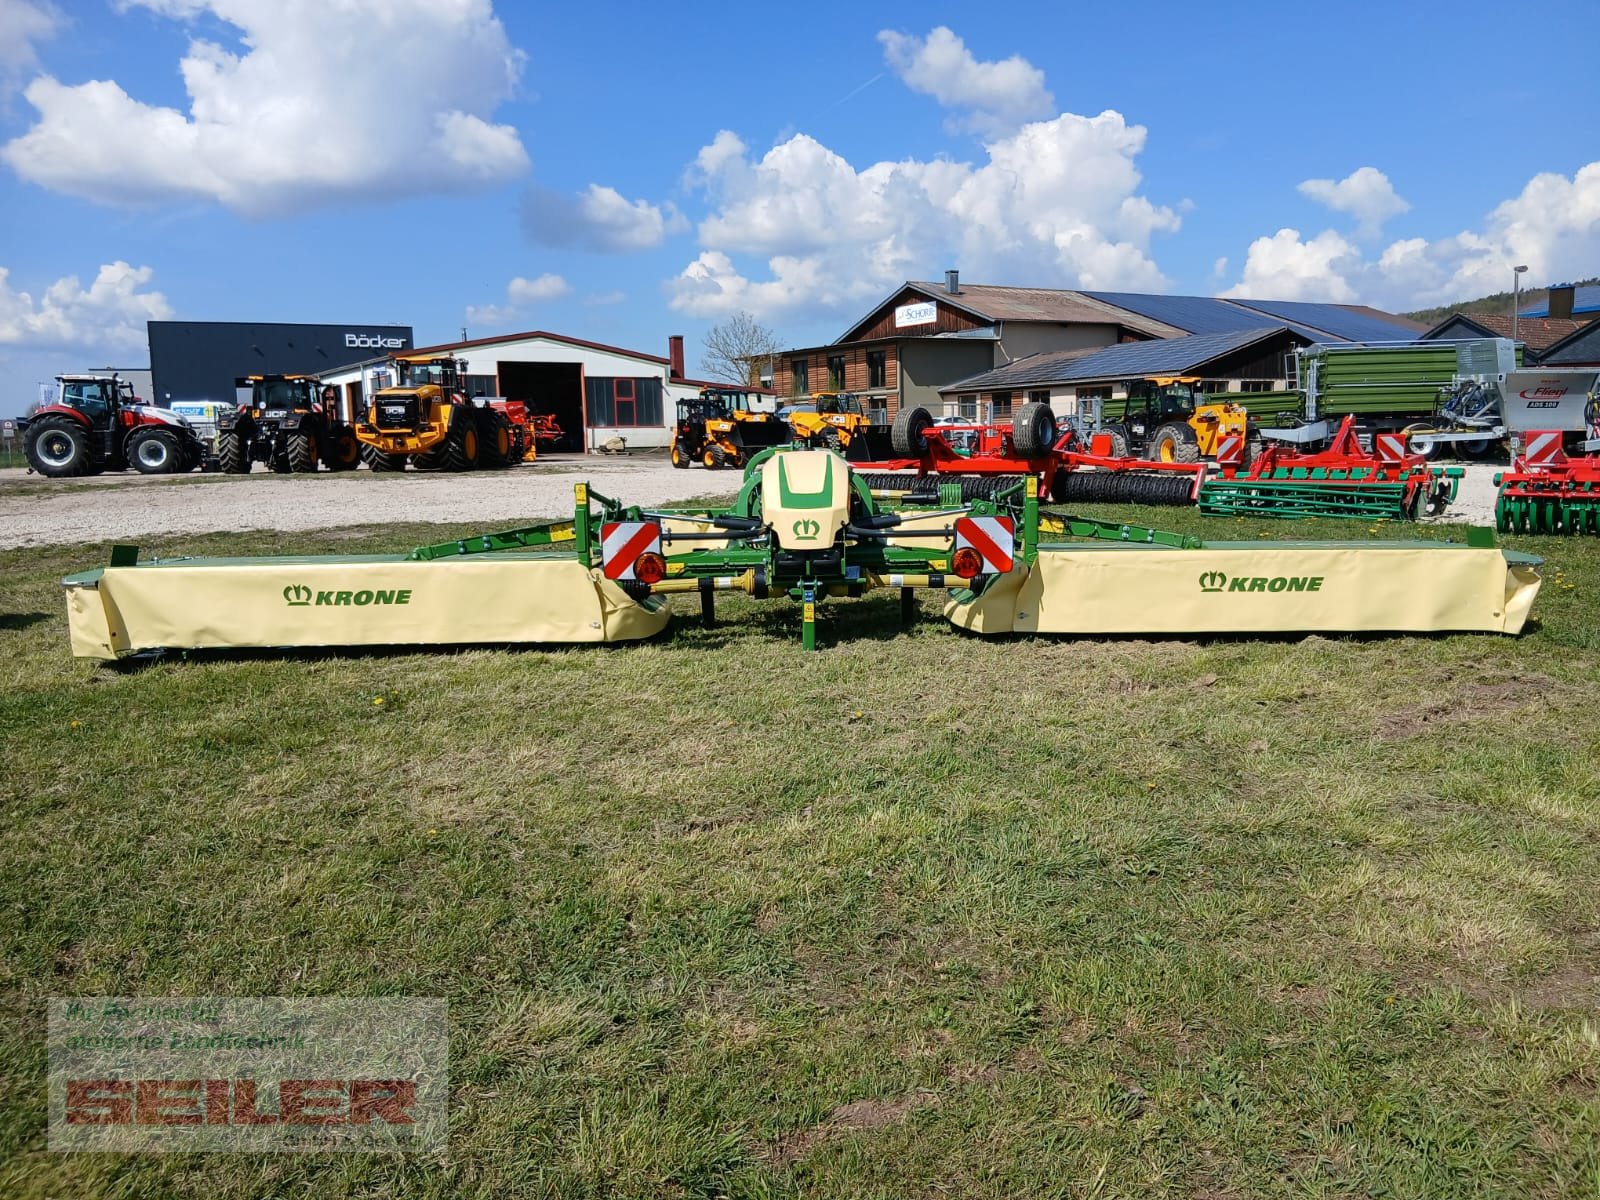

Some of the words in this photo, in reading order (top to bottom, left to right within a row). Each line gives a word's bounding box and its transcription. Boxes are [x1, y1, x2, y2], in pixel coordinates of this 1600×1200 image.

[345, 333, 406, 348] Böcker
[265, 410, 287, 418] JCB
[1227, 577, 1325, 593] KRONE
[315, 589, 413, 606] KRONE
